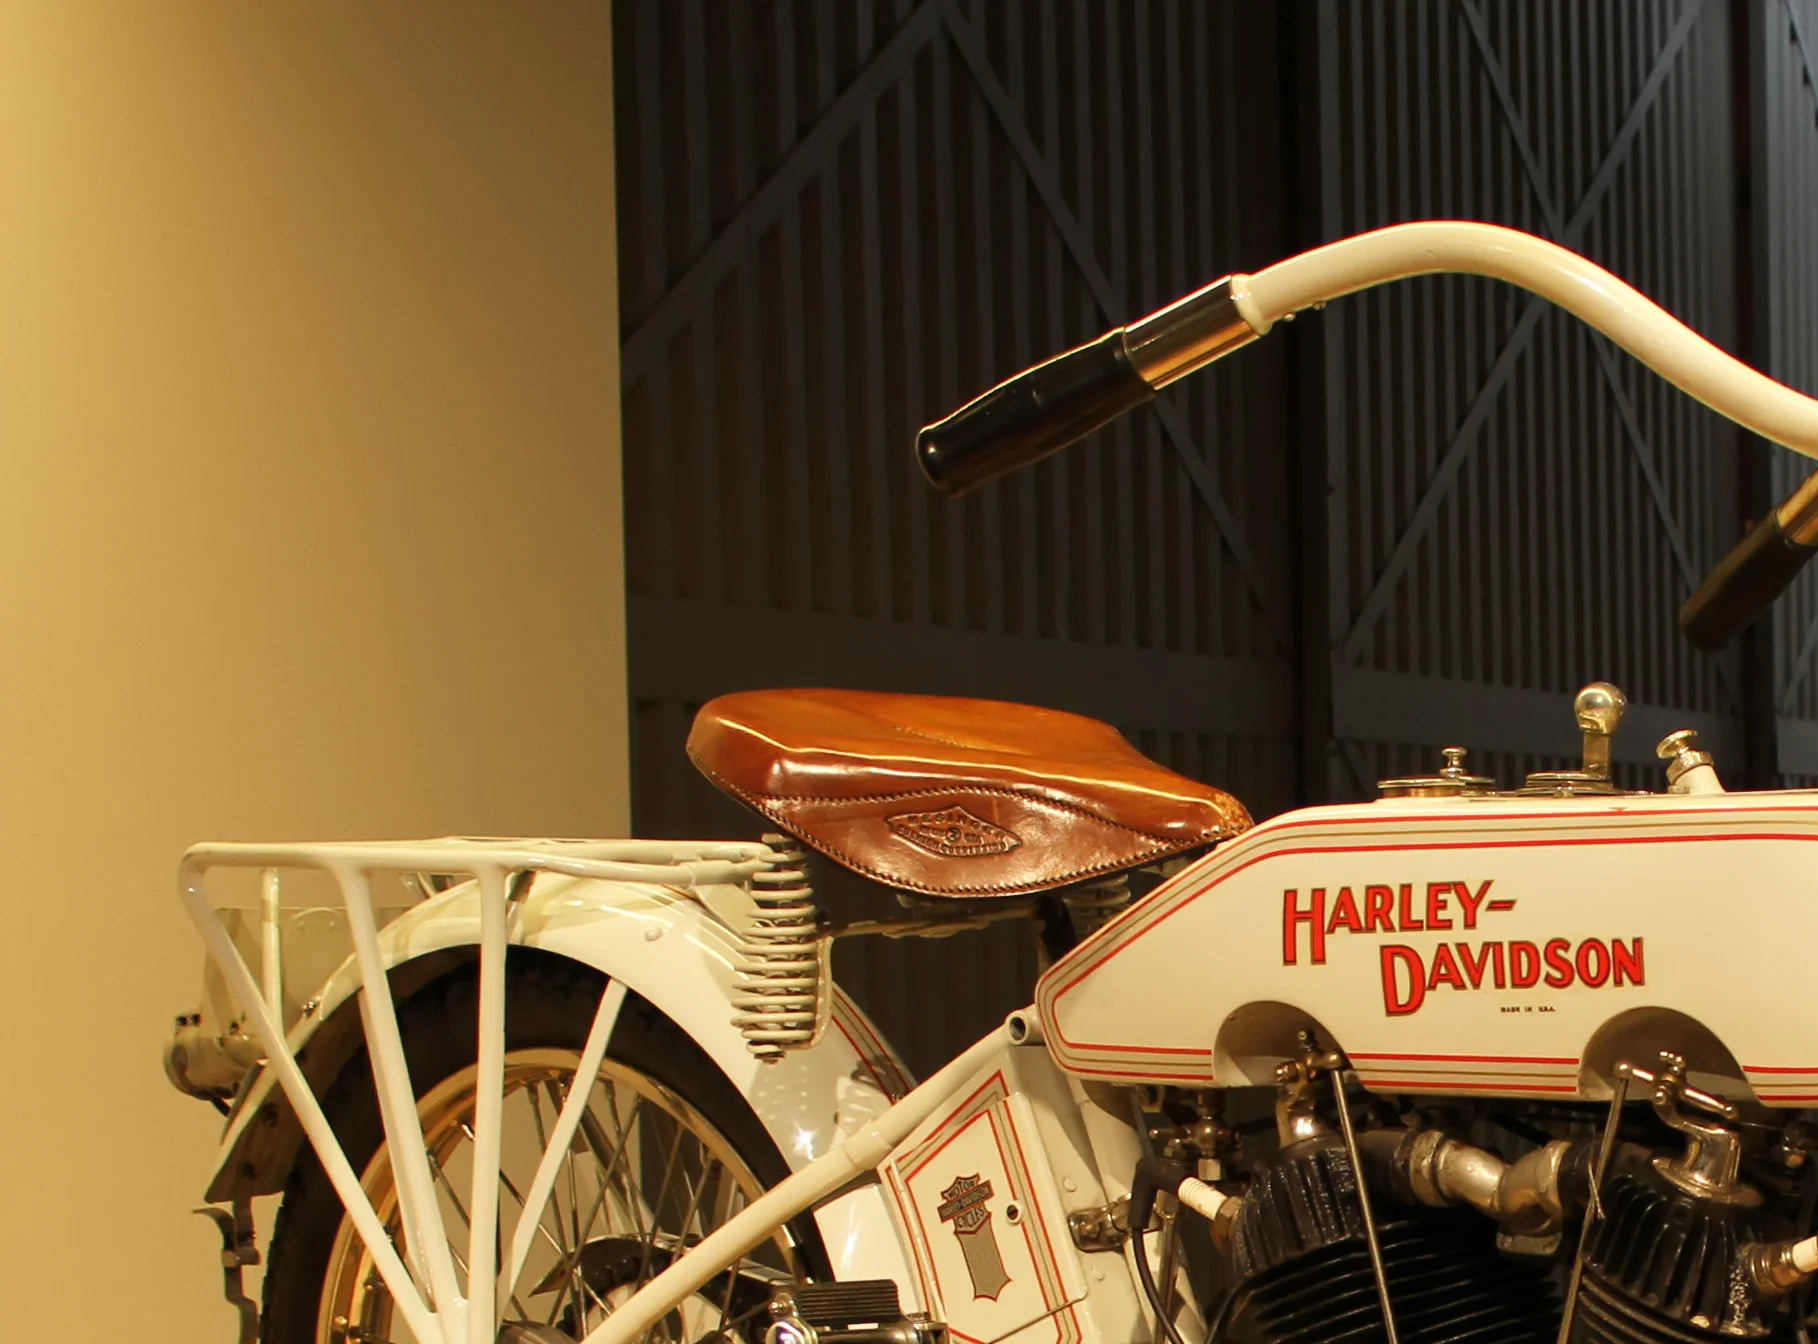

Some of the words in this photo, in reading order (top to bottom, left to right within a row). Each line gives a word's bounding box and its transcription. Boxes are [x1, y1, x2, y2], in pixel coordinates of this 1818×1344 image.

[1282, 879, 1516, 966] HARLEY-
[1380, 937, 1645, 1016] DAVIDSON
[1500, 1005, 1521, 1013] MADE
[957, 1206, 985, 1227] CYCLES
